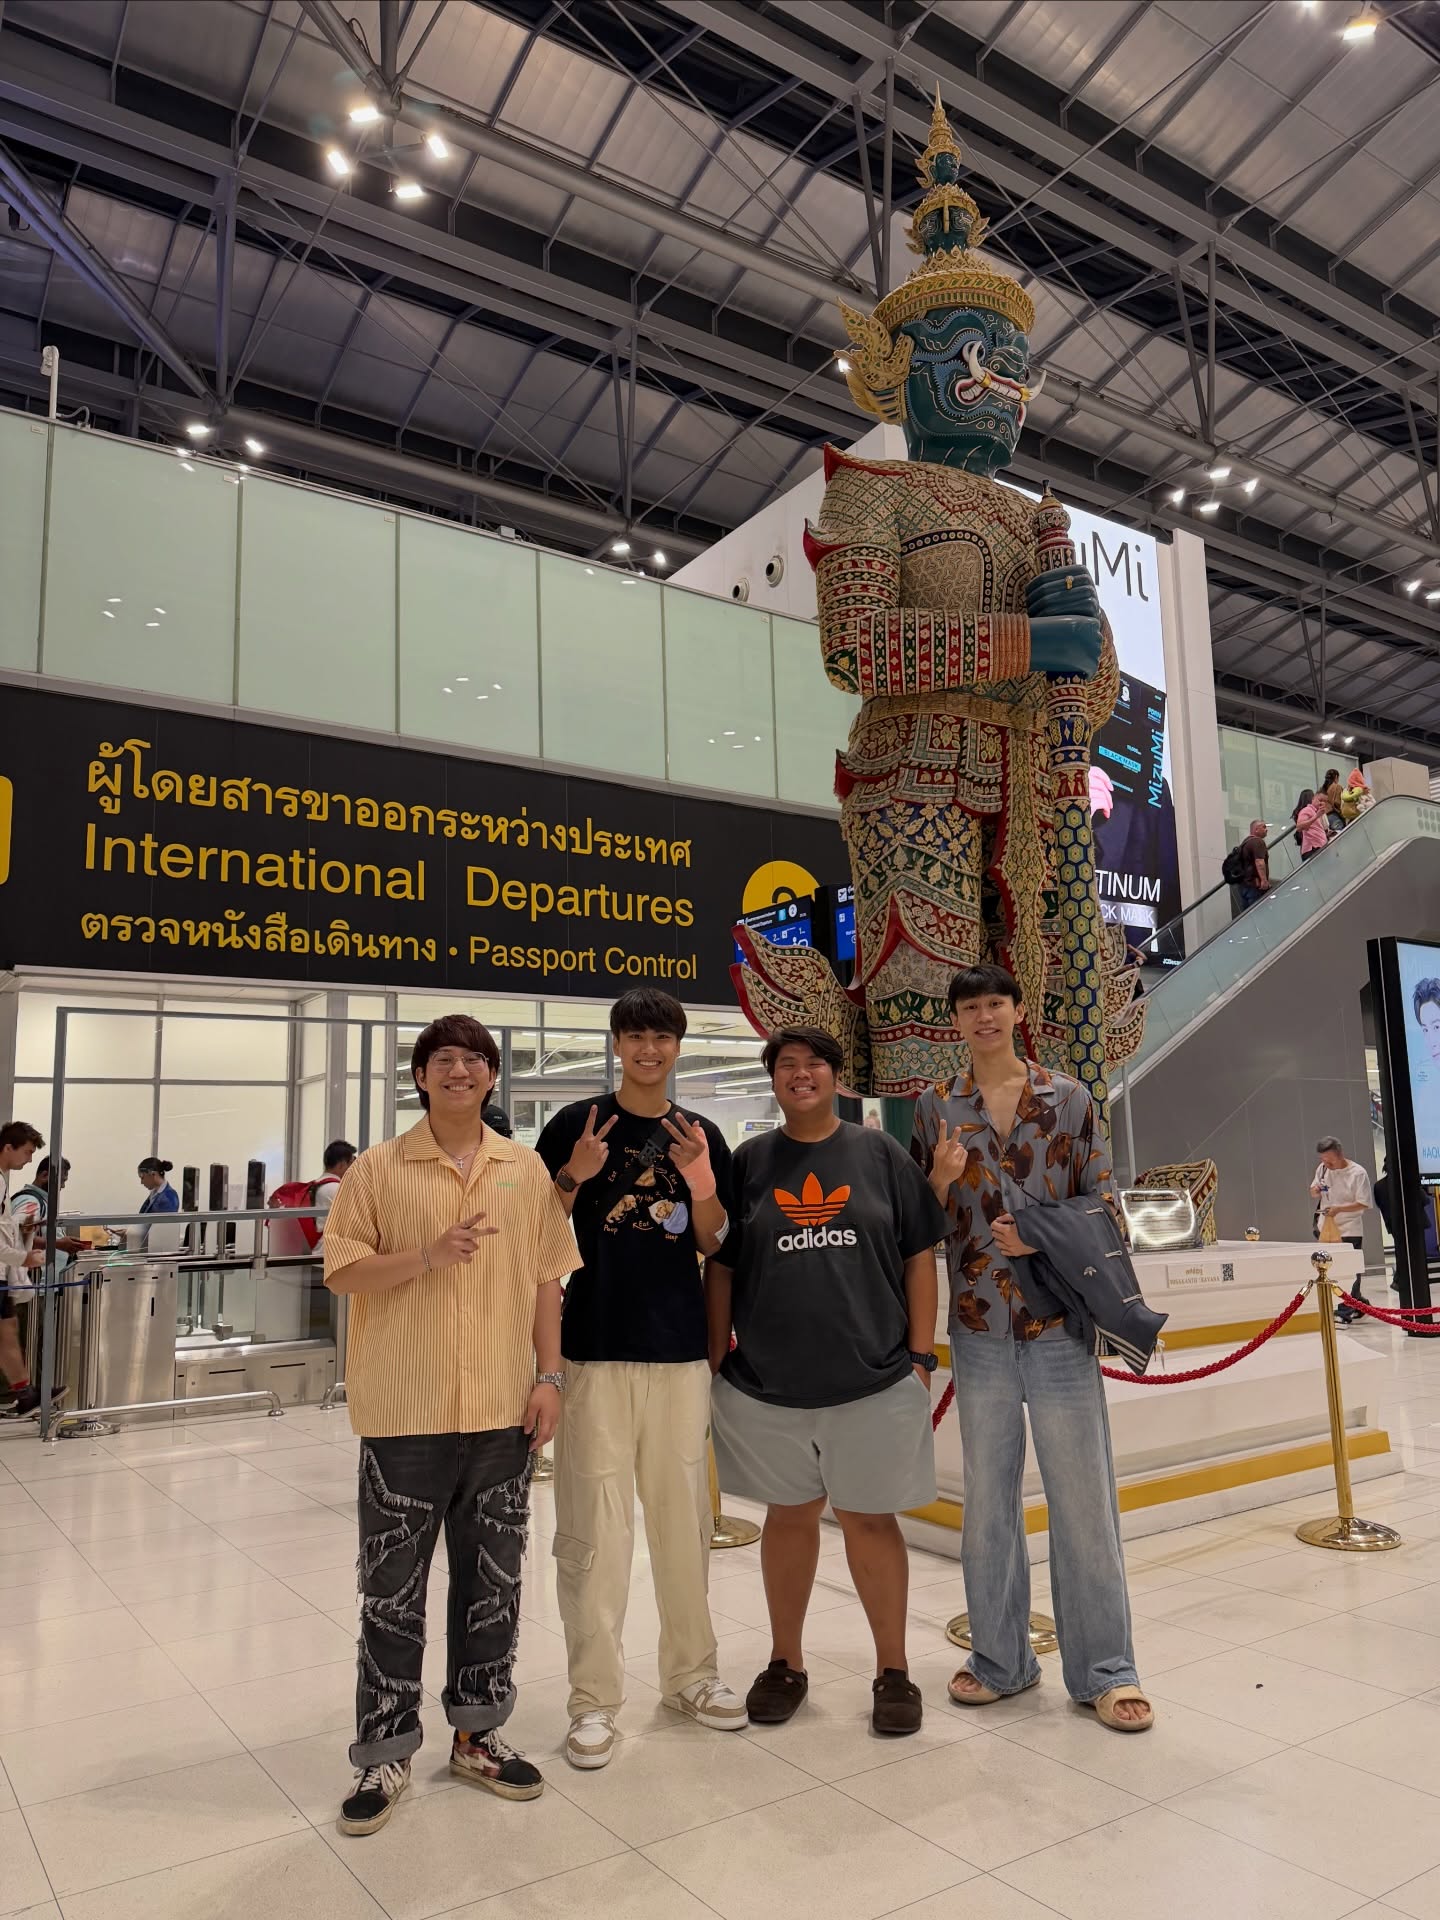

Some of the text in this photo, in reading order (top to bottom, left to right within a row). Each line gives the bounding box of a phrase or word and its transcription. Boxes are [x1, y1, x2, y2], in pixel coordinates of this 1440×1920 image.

[1148, 728, 1164, 809] MizuMi
[88, 739, 692, 868] ผู้โดยสารขาออกระหว่างประเทศ
[85, 823, 694, 927] International Departures
[81, 909, 436, 962] ตรวจหนังสือเดินทาง
[469, 936, 698, 979] Passport Control
[778, 1226, 857, 1251] adidas
